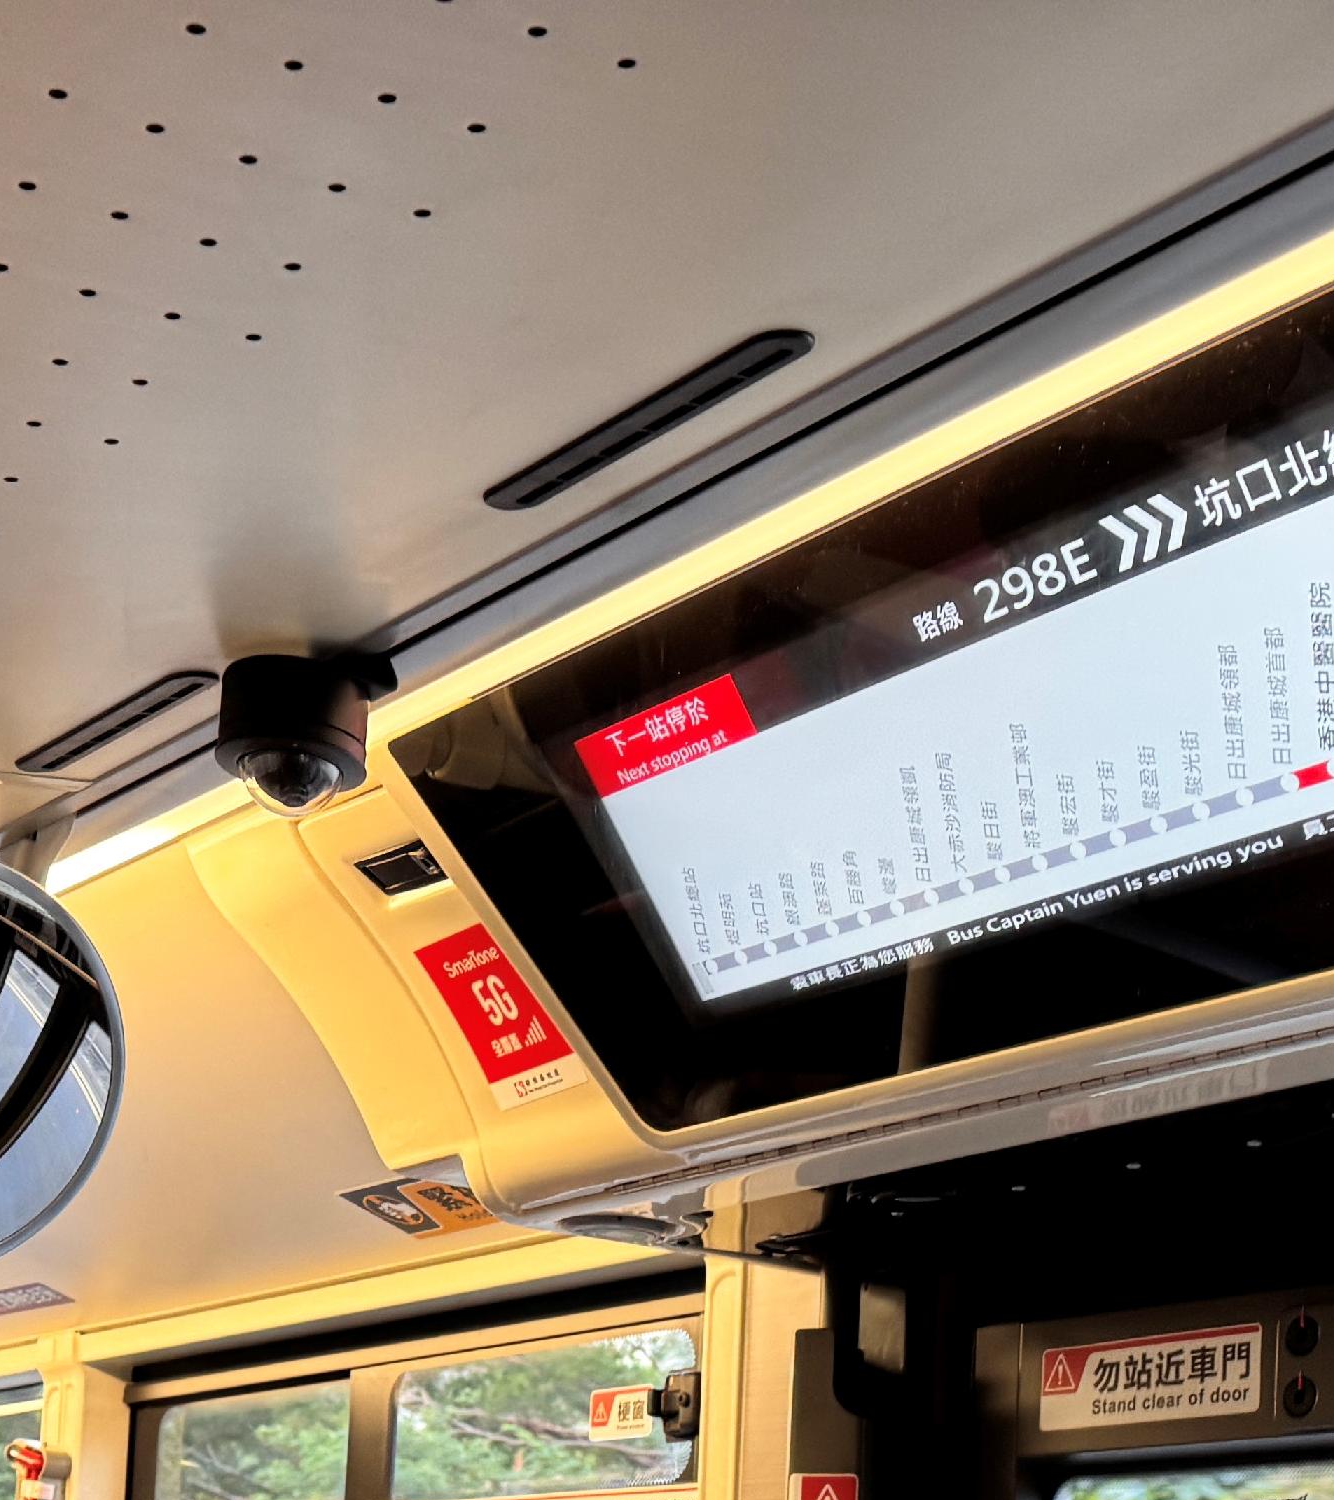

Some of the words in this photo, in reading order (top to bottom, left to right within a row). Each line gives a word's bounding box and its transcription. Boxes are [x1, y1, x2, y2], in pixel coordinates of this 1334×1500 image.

[912, 601, 964, 643] 路線
[974, 537, 1099, 623] 298E
[1217, 645, 1248, 780] 日出康城領都
[1264, 626, 1293, 765] 日出康城首都
[605, 698, 710, 757] 下一站停於
[617, 761, 649, 785] Next
[651, 736, 711, 775] stopping
[714, 729, 728, 746] at
[1179, 729, 1203, 797] 駿光街
[681, 867, 710, 954] 坑口北總站
[748, 882, 770, 935] 坑口站
[946, 922, 984, 947] Bus
[986, 899, 1065, 936] Captain
[1065, 883, 1121, 910] Yuen
[1123, 876, 1143, 893] is
[1146, 846, 1233, 887] serving
[1236, 834, 1284, 861] you
[442, 945, 501, 979] SmarTone
[471, 973, 520, 1027] 5G
[1092, 1341, 1252, 1394] 勿站近車門
[1092, 1397, 1136, 1415] Stand
[1142, 1393, 1181, 1411] clear
[1188, 1391, 1205, 1406] of
[1210, 1387, 1250, 1404] door
